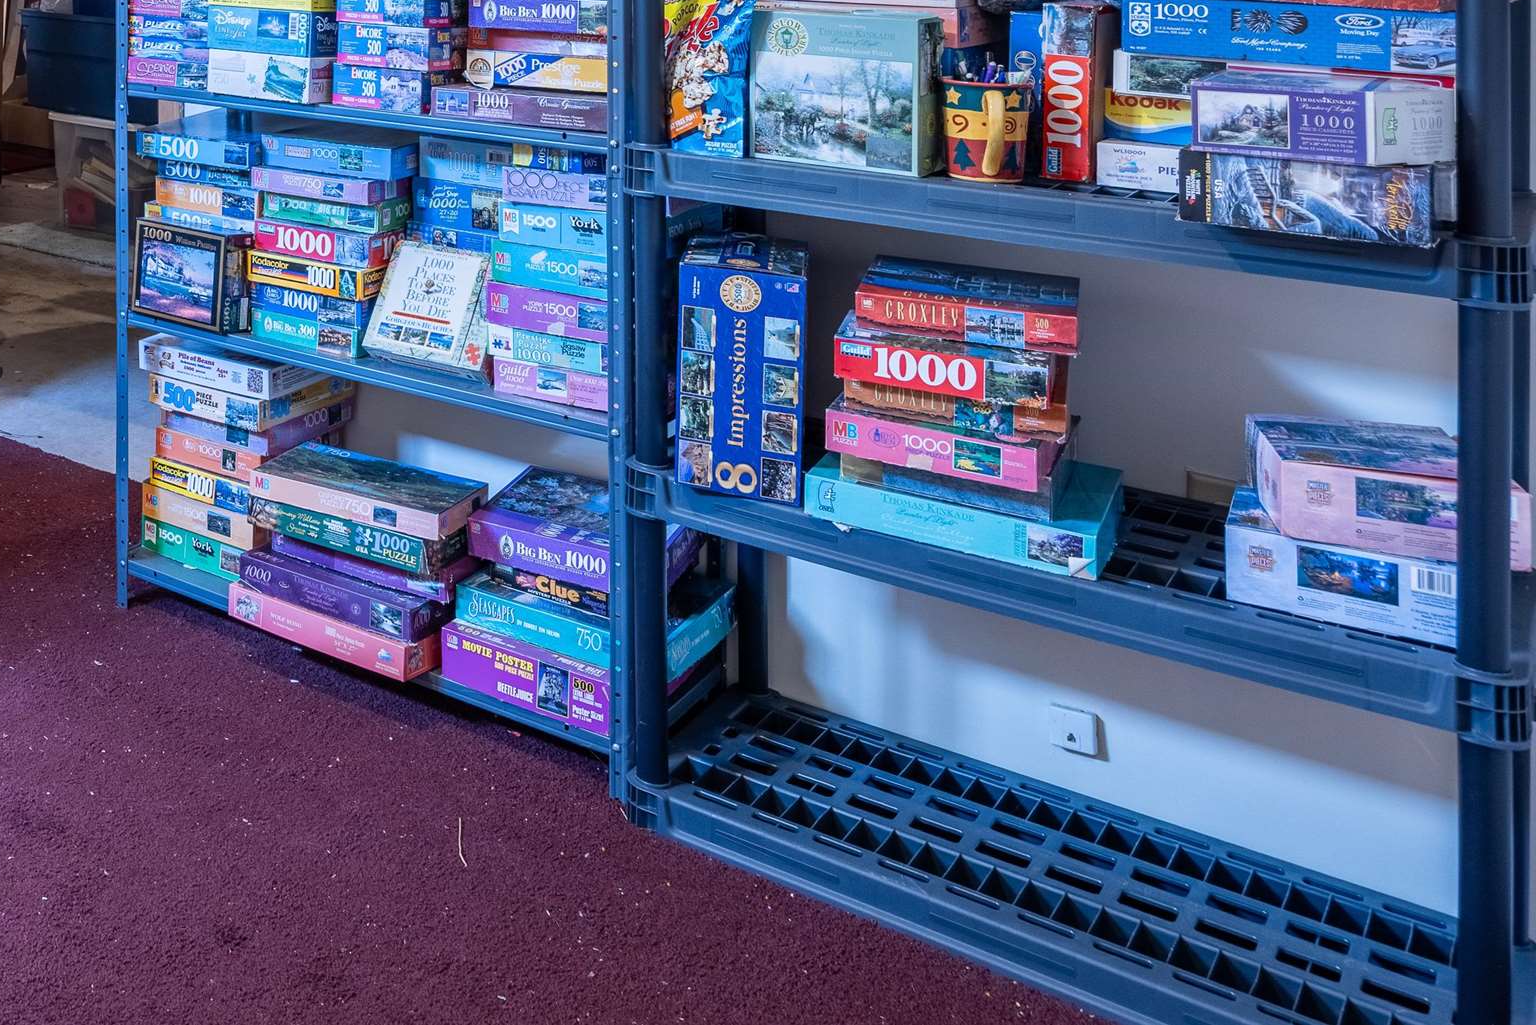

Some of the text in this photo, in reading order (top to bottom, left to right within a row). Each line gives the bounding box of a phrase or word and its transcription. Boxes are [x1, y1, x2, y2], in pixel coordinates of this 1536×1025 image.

[499, 2, 576, 20] BIG BEN 1000
[1154, 3, 1209, 20] 1000
[144, 20, 184, 29] PUZZLE
[298, 13, 307, 44] 1000
[1346, 16, 1373, 27] Ford
[356, 26, 382, 39] ENCORE
[1339, 28, 1379, 37] Moving Day
[144, 41, 182, 51] PUZZLE
[367, 39, 381, 55] 500
[352, 68, 377, 81] ENCORE
[362, 80, 376, 96] 500
[476, 92, 508, 109] 1000
[1046, 60, 1084, 148] 1000
[1110, 96, 1182, 111] Kodak
[1300, 114, 1354, 130] 1000
[159, 136, 198, 159] 500
[189, 187, 221, 208] 1000
[1214, 179, 1222, 199] USA
[523, 214, 556, 228] 1500
[569, 216, 600, 231] York
[143, 226, 172, 242] 1000
[276, 226, 332, 257] 1000
[252, 256, 290, 270] Kodacolor
[546, 261, 577, 276] 1500
[306, 267, 335, 289] 1000
[282, 287, 317, 313] 1000
[544, 302, 576, 318] 1500
[298, 325, 316, 338] 300
[843, 344, 871, 357] Guild
[498, 363, 530, 378] Guild
[874, 347, 976, 391] 1000
[727, 318, 749, 448] Impressions
[164, 381, 196, 412] 500
[834, 421, 858, 438] MB
[832, 436, 858, 447] PUZZLE
[903, 434, 951, 454] 1000
[157, 528, 183, 545] 1500
[191, 536, 214, 552] York
[371, 531, 409, 554] 1000
[382, 549, 416, 565] PUZZLE
[516, 542, 606, 575] BIG BEN 1000
[535, 576, 580, 603] Clue
[468, 592, 514, 625] SEASCAPES
[576, 627, 602, 651] 750
[462, 640, 534, 672] MOVIE POSTER
[573, 677, 594, 694] 500
